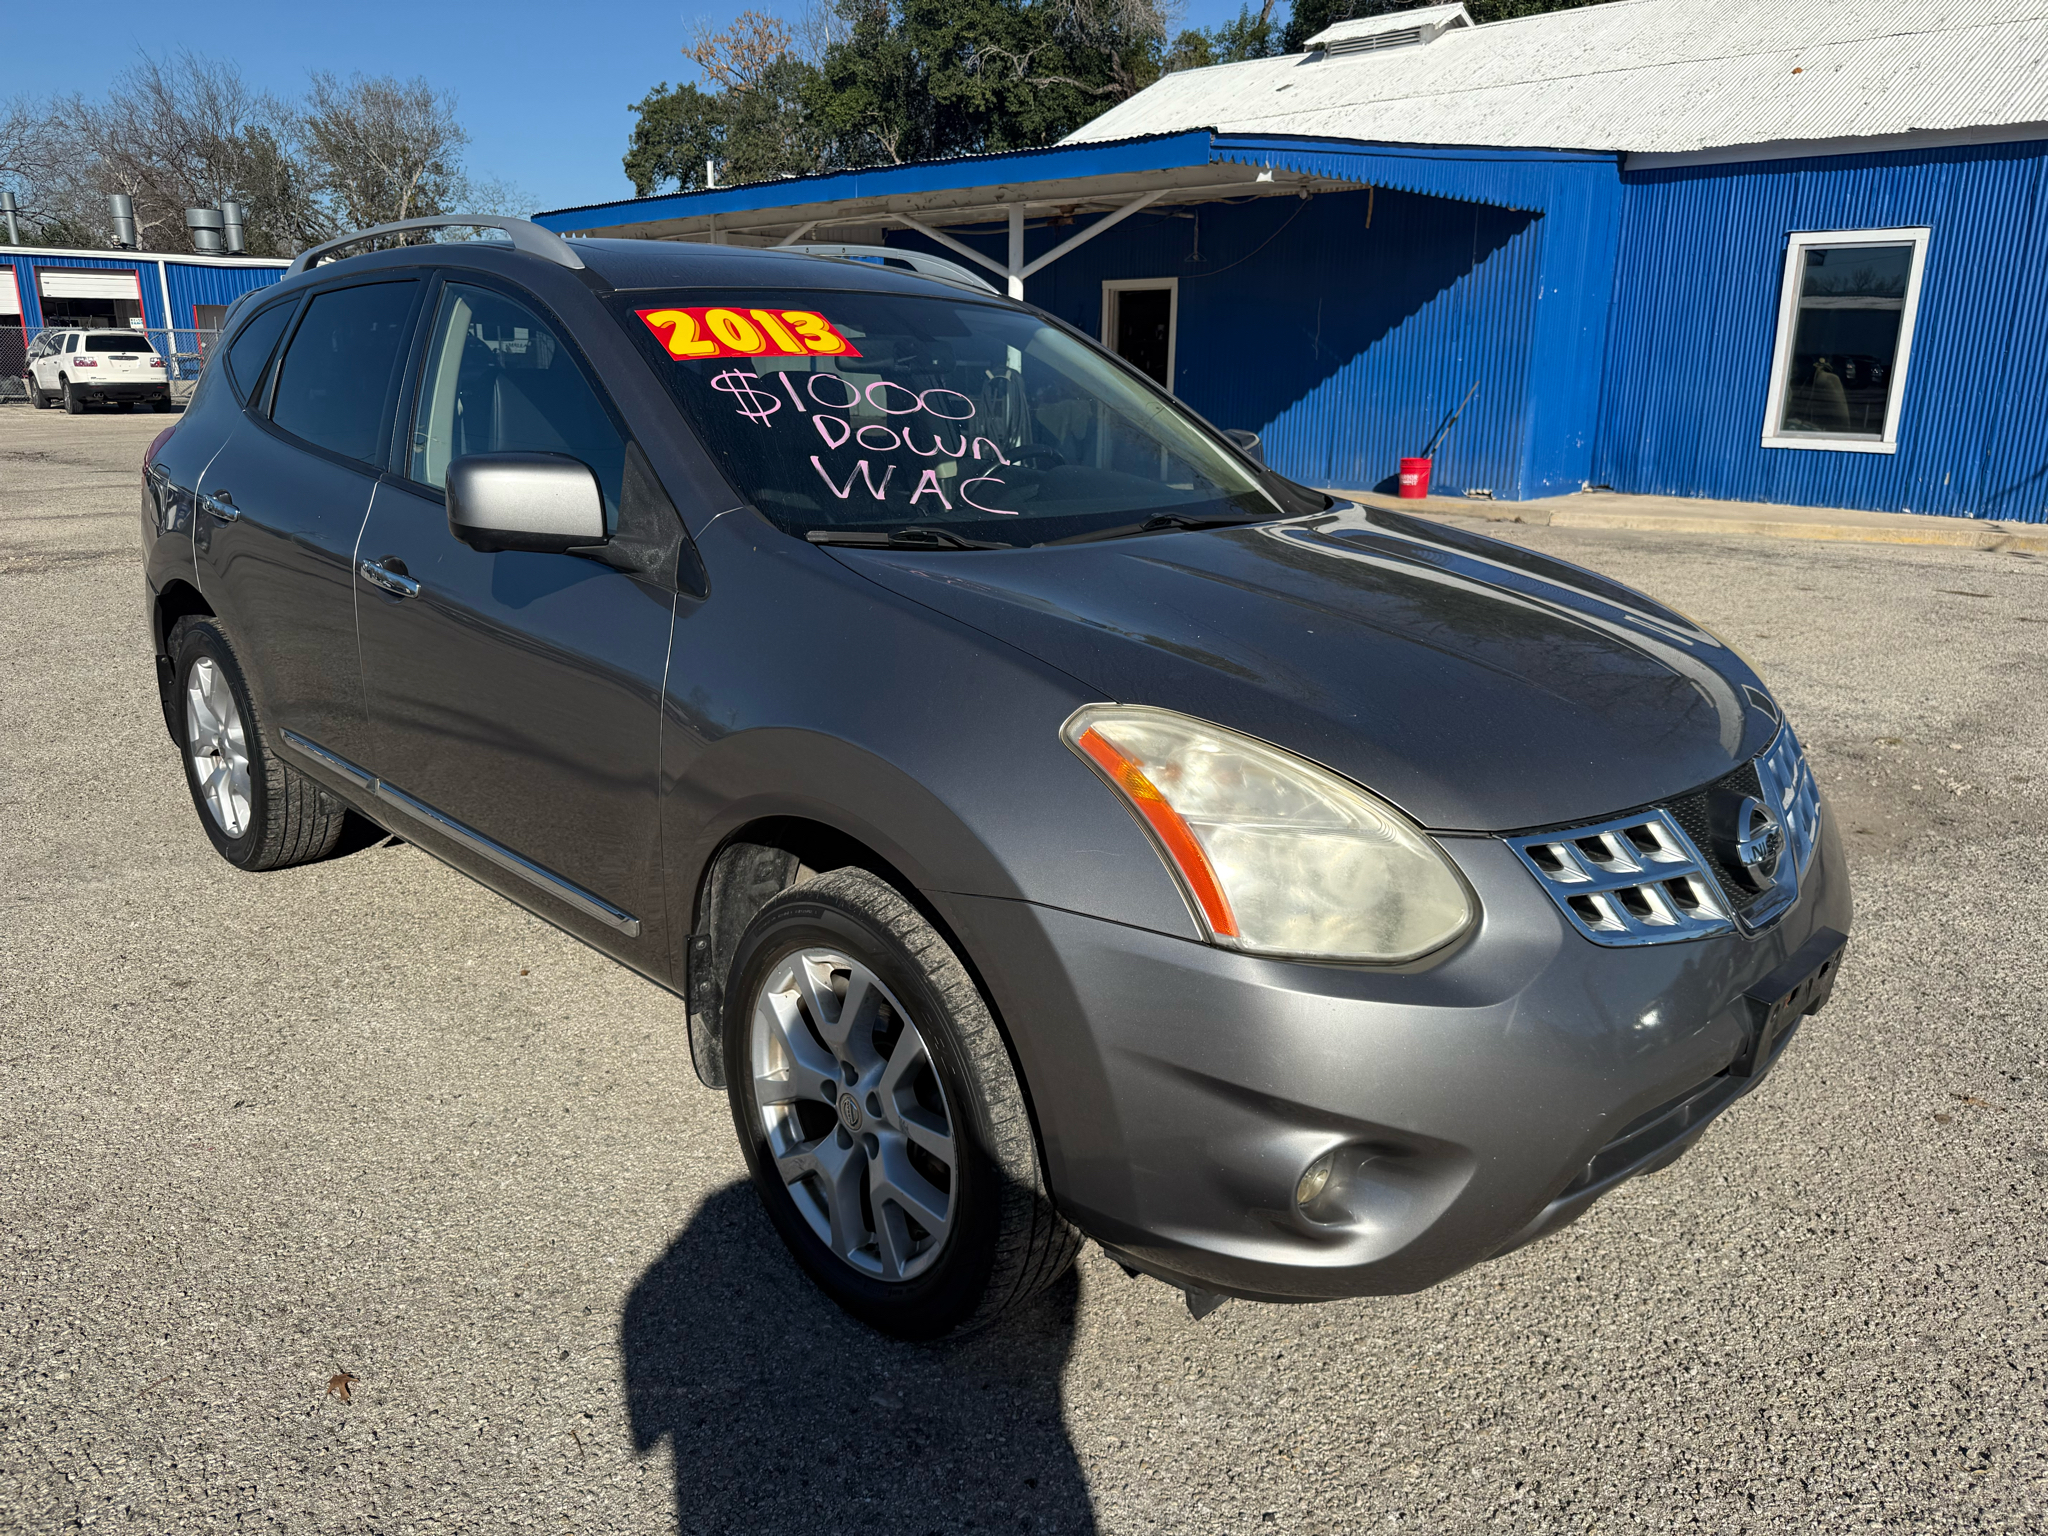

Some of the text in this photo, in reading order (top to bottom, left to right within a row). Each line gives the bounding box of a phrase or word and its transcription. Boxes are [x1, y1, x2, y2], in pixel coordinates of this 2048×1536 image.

[646, 308, 846, 356] 2013
[710, 368, 976, 427] $1000
[810, 455, 1020, 515] WAC
